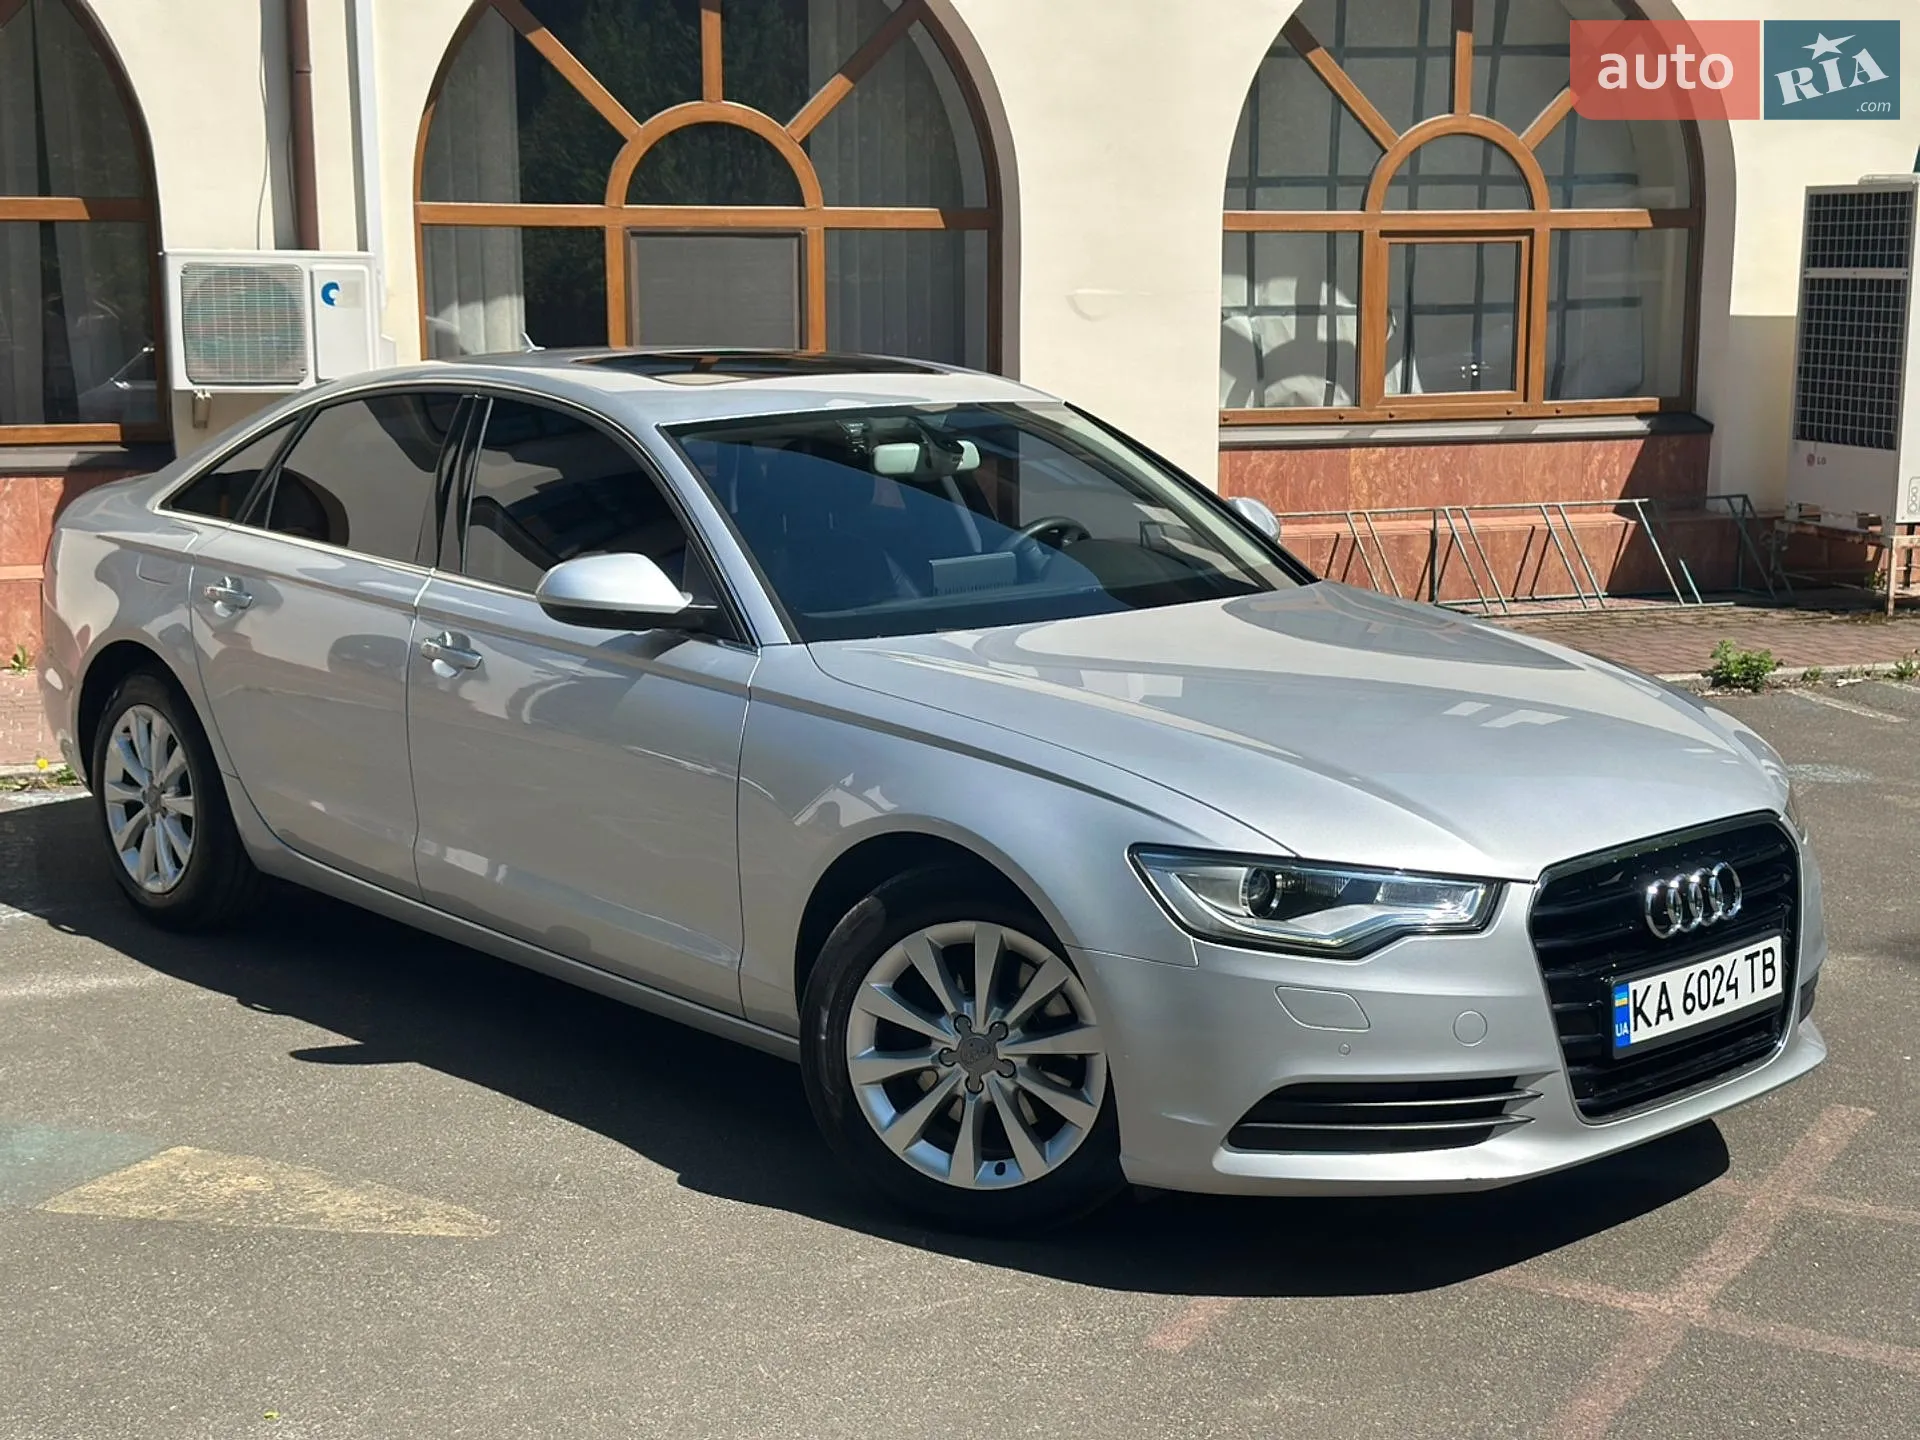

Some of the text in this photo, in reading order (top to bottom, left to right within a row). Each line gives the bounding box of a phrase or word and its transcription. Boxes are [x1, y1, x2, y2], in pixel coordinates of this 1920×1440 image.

[1632, 946, 1777, 1032] KA 6024 TB
[1615, 1023, 1629, 1037] UA
